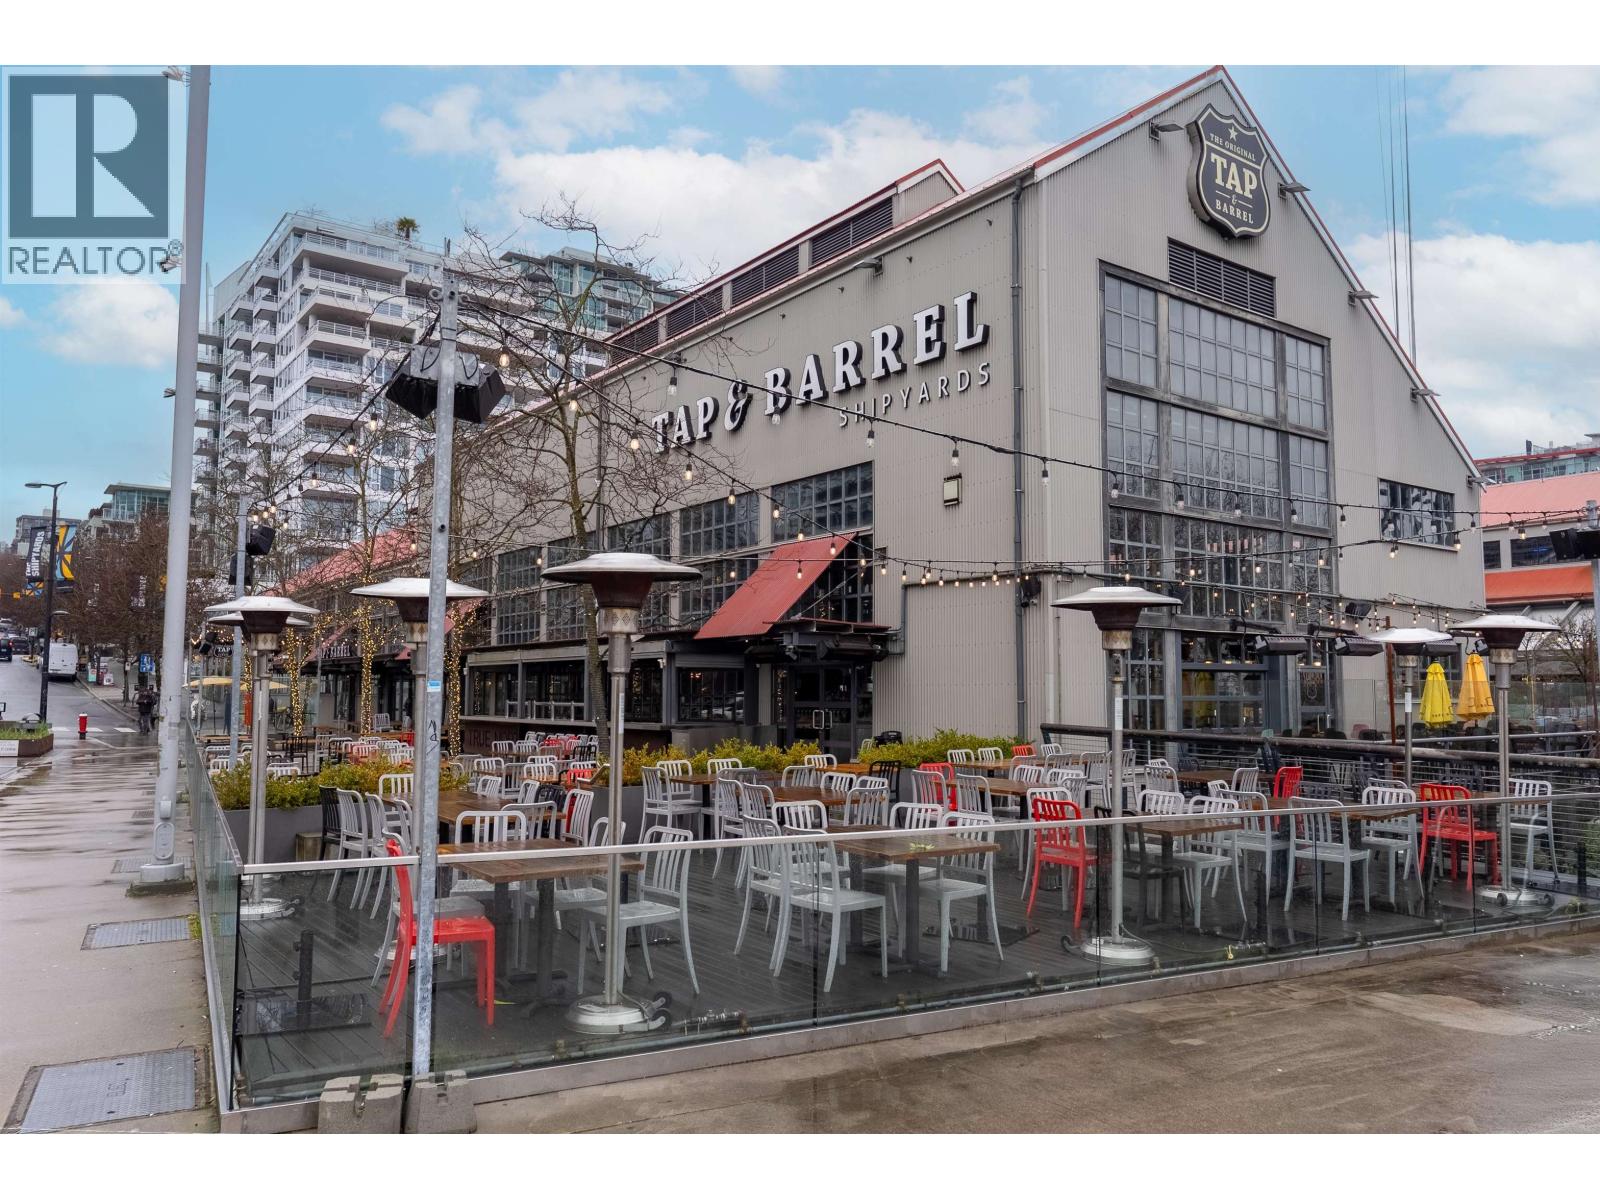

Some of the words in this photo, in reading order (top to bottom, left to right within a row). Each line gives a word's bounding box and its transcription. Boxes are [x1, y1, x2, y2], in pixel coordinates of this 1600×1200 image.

[1209, 133, 1224, 146] THE
[1224, 141, 1256, 161] ORIGINAL
[1210, 152, 1258, 199] TAP
[1215, 198, 1254, 224] BARREL
[652, 395, 719, 454] TAP
[724, 379, 753, 432] &
[765, 291, 990, 416] BARREL
[839, 361, 992, 428] SHIPYARDS
[31, 531, 45, 577] SHIPYARDS
